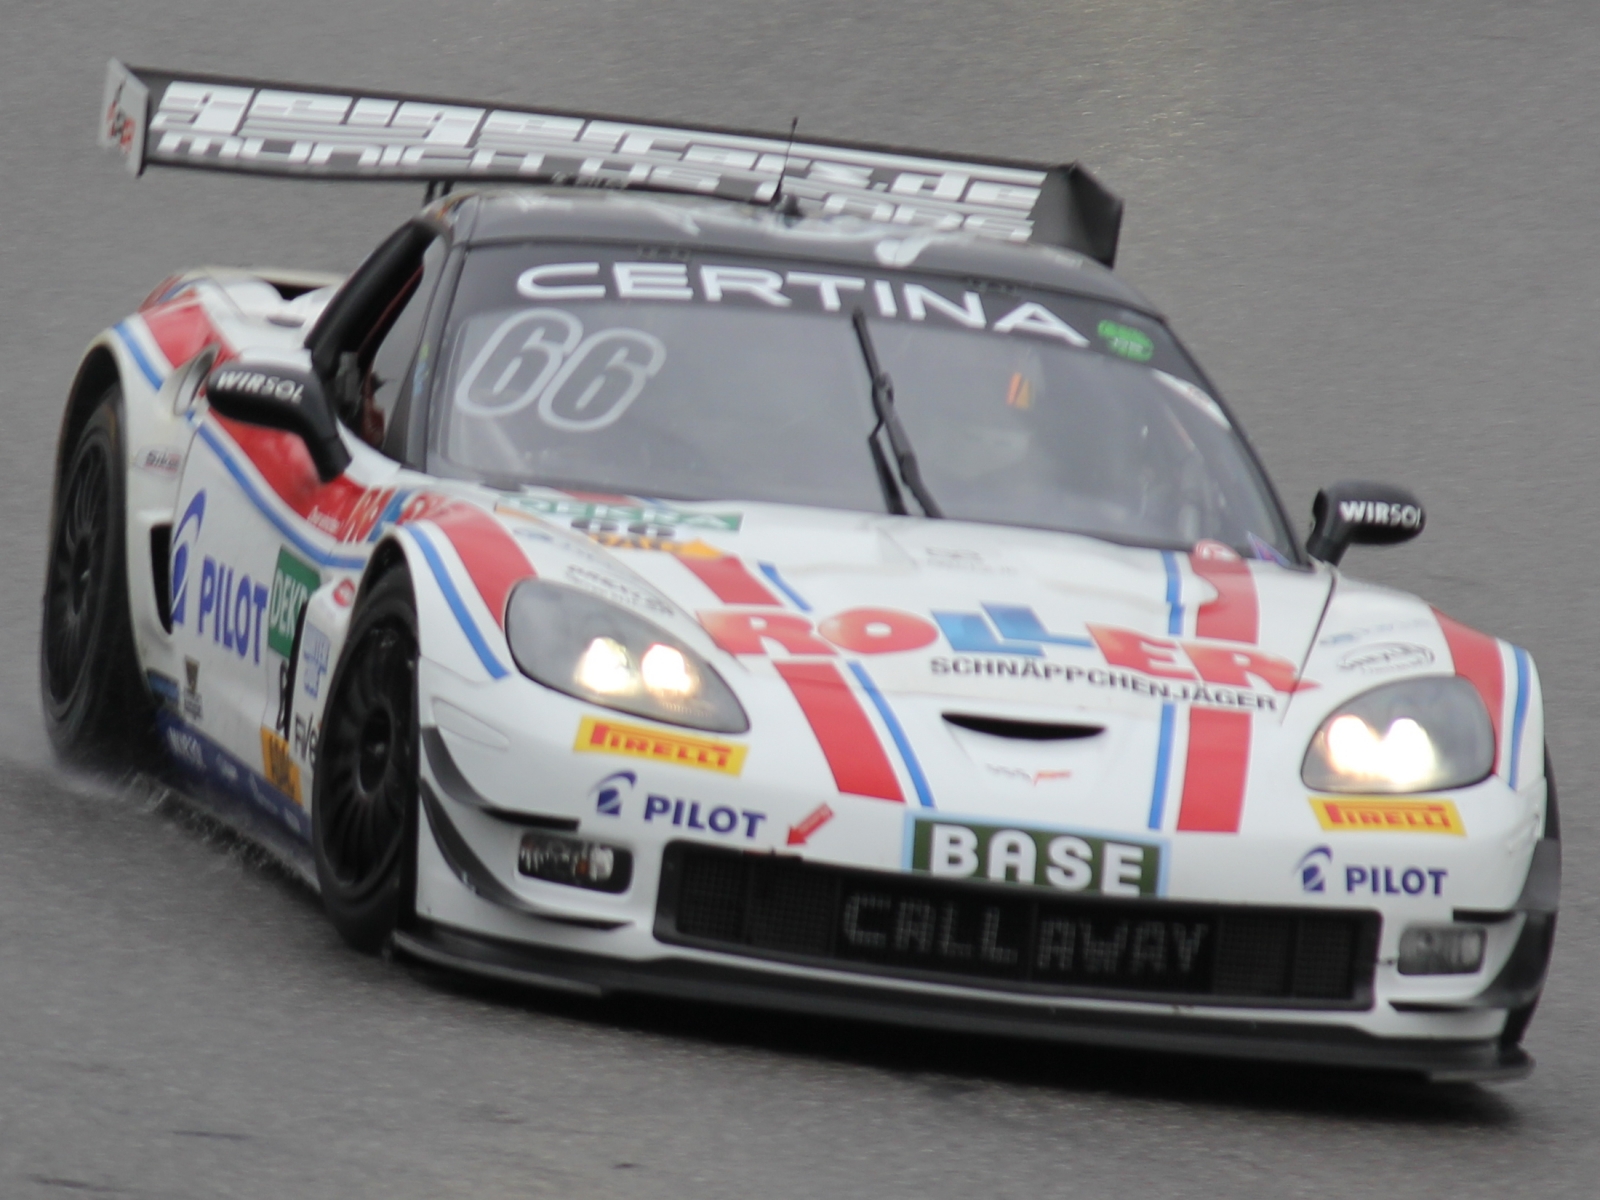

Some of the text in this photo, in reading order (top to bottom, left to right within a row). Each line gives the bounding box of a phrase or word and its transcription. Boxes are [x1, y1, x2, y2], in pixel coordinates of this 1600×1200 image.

[516, 262, 1089, 347] CERTINA
[216, 370, 304, 404] WIRSOL
[454, 307, 667, 432] 66
[198, 554, 269, 666] PILOT
[694, 603, 1320, 694] ROLLER
[930, 655, 1278, 712] SCHNÄPPCHENJÄGER
[589, 722, 732, 769] PIRELLI
[643, 794, 767, 838] PILOT
[1323, 802, 1453, 829] PIRELLI
[929, 822, 1145, 897] BASE
[1345, 865, 1448, 896] PILOT
